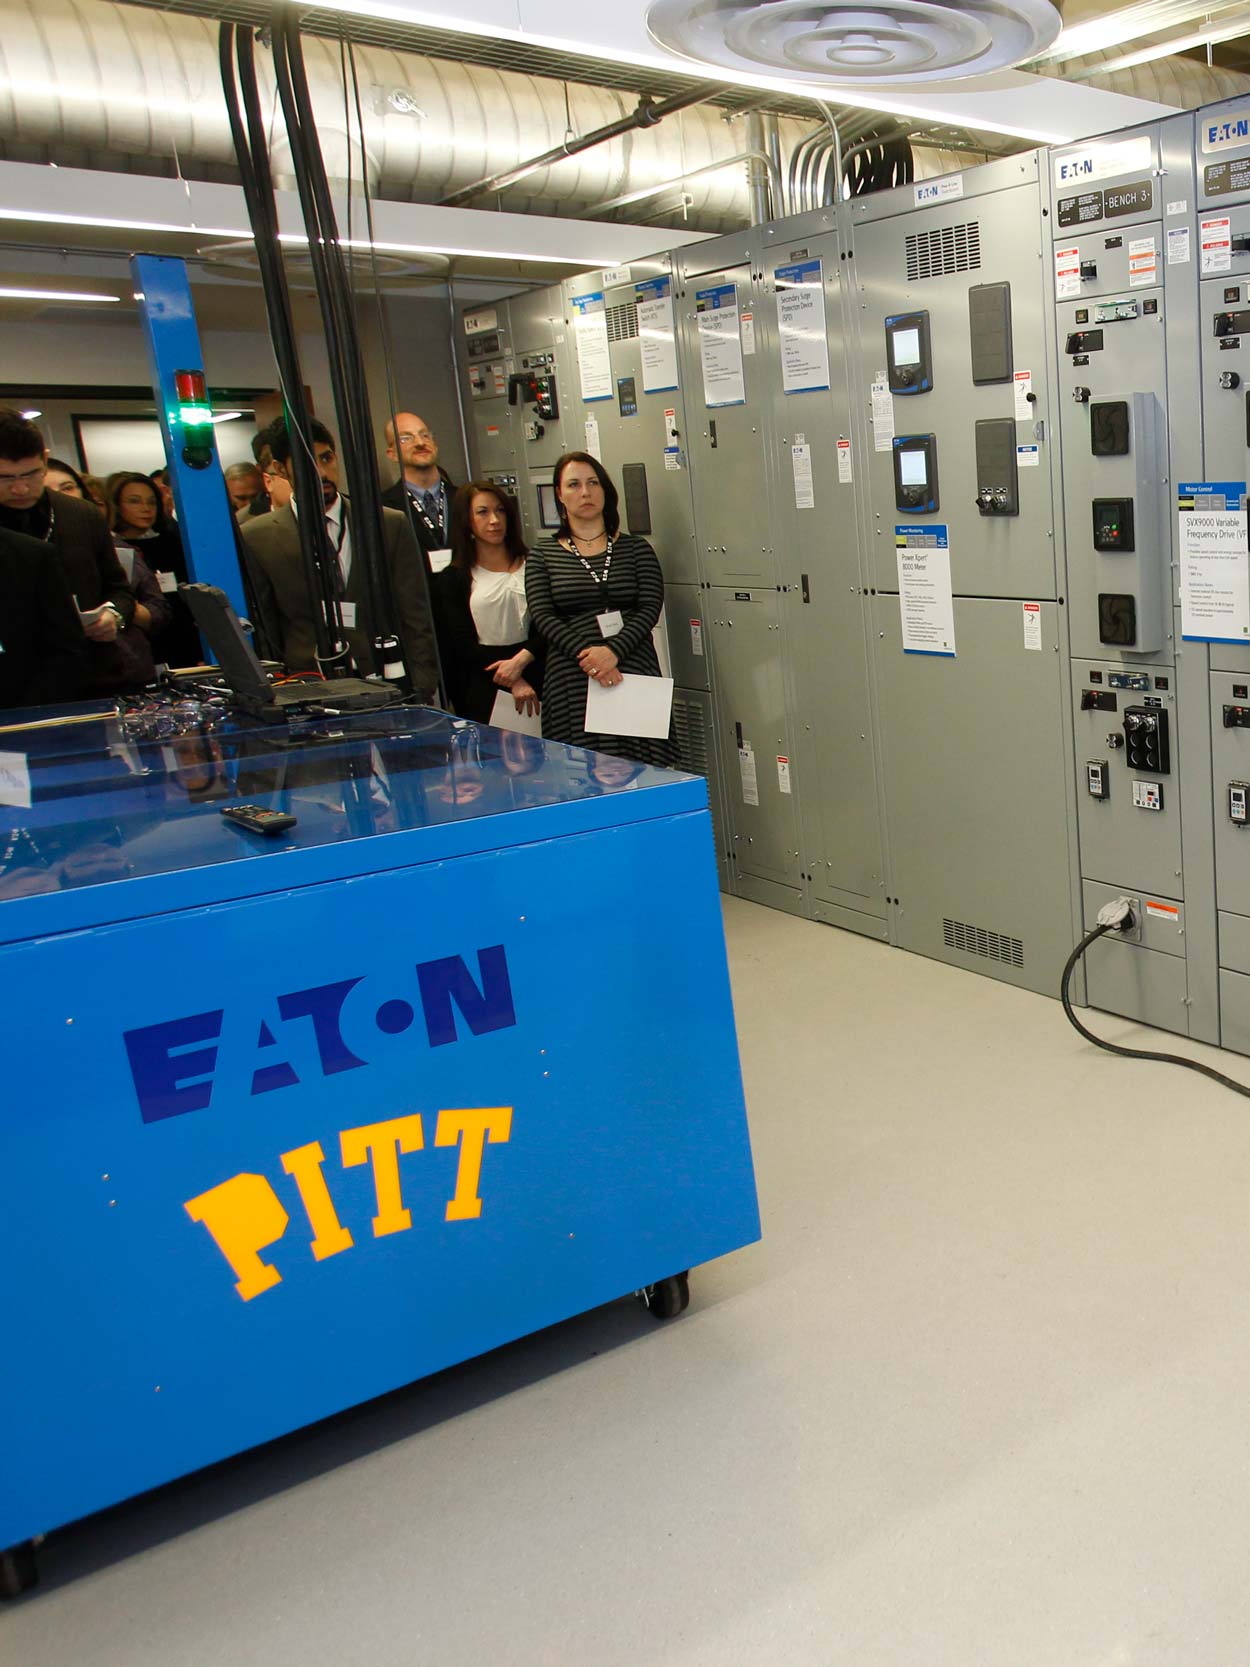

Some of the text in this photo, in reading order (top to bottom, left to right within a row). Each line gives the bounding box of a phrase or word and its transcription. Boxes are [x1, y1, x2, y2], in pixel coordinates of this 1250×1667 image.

[1208, 119, 1248, 143] EATON
[1061, 158, 1093, 179] EATON
[1108, 193, 1137, 209] BENCH
[1140, 190, 1147, 202] 3
[1186, 517, 1240, 527] SVX9000 Variable
[1186, 529, 1247, 539] Frequency Drive (VF
[901, 553, 914, 561] Power
[122, 943, 517, 1125] EATON
[182, 1106, 513, 1303] PITT
